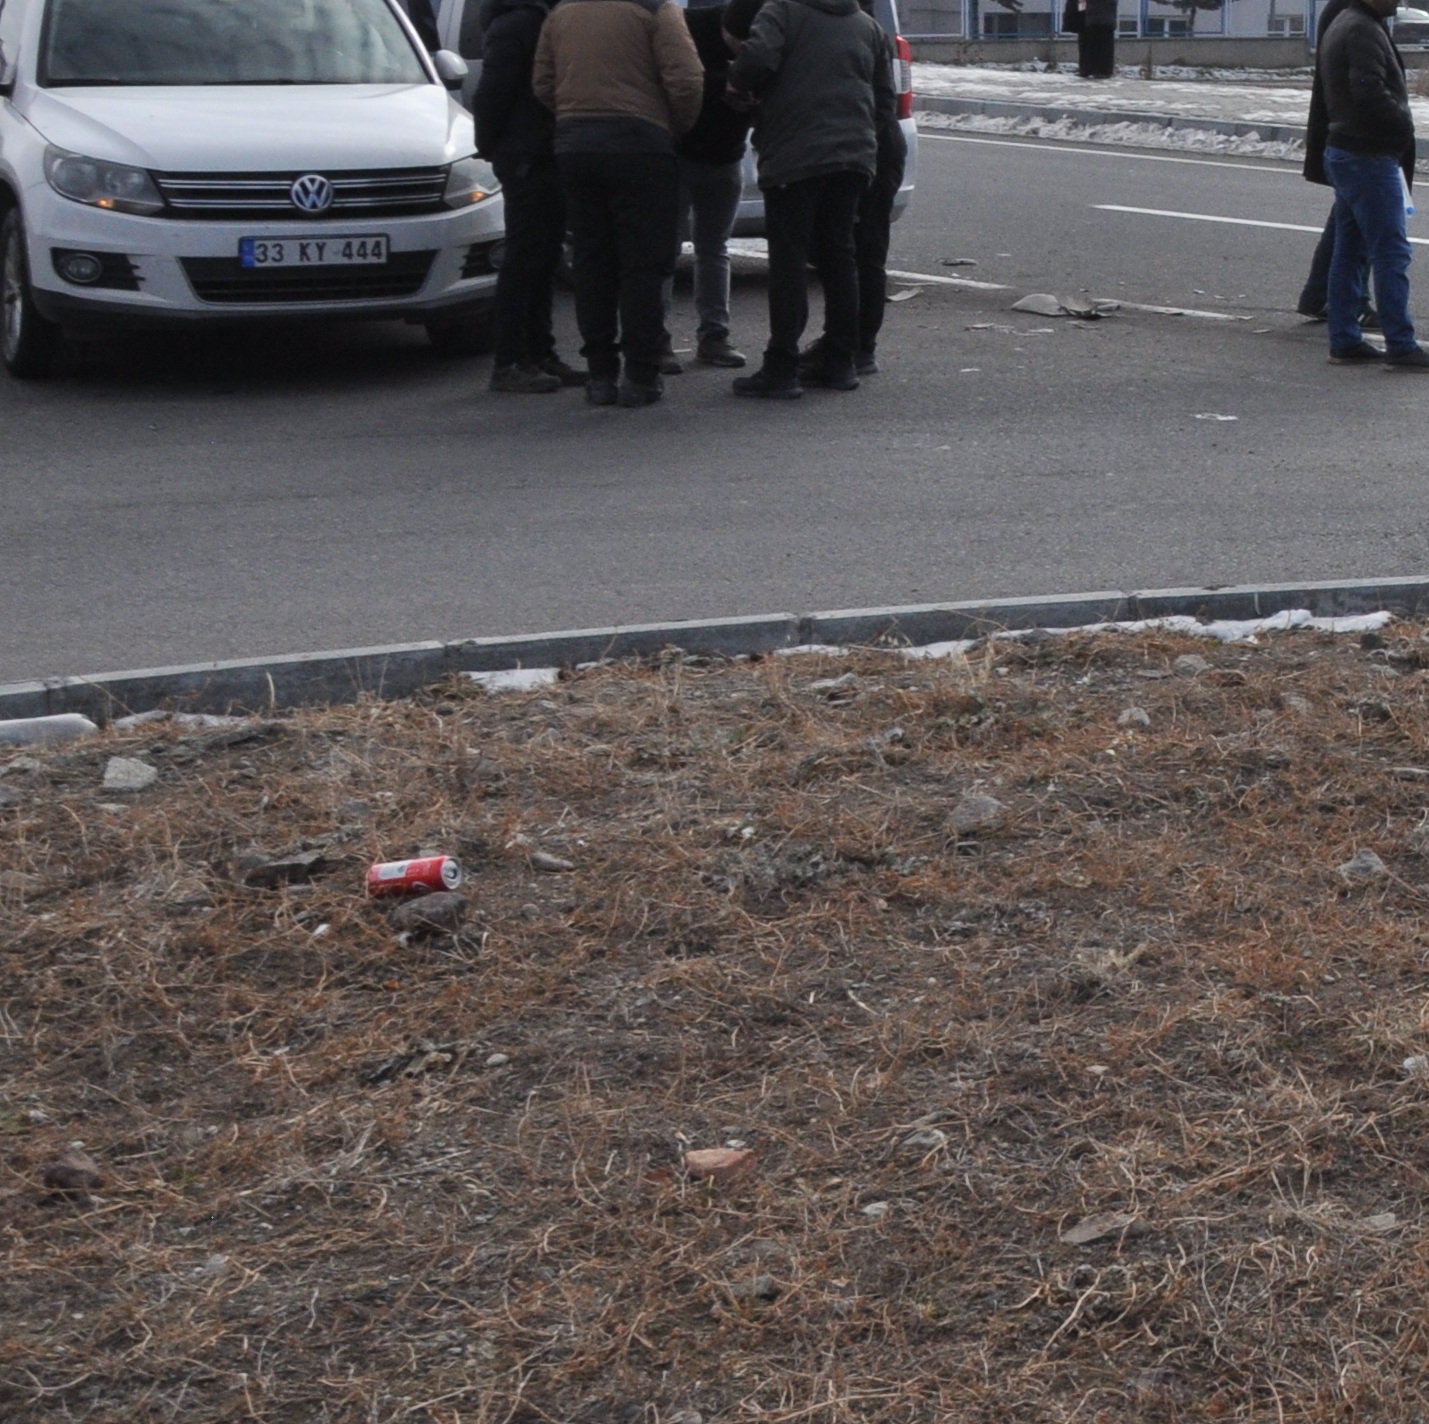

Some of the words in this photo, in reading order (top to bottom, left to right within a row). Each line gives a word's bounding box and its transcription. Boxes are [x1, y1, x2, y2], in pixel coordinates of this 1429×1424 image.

[256, 243, 284, 263] 33
[299, 242, 327, 262] KY
[342, 240, 383, 260] 444
